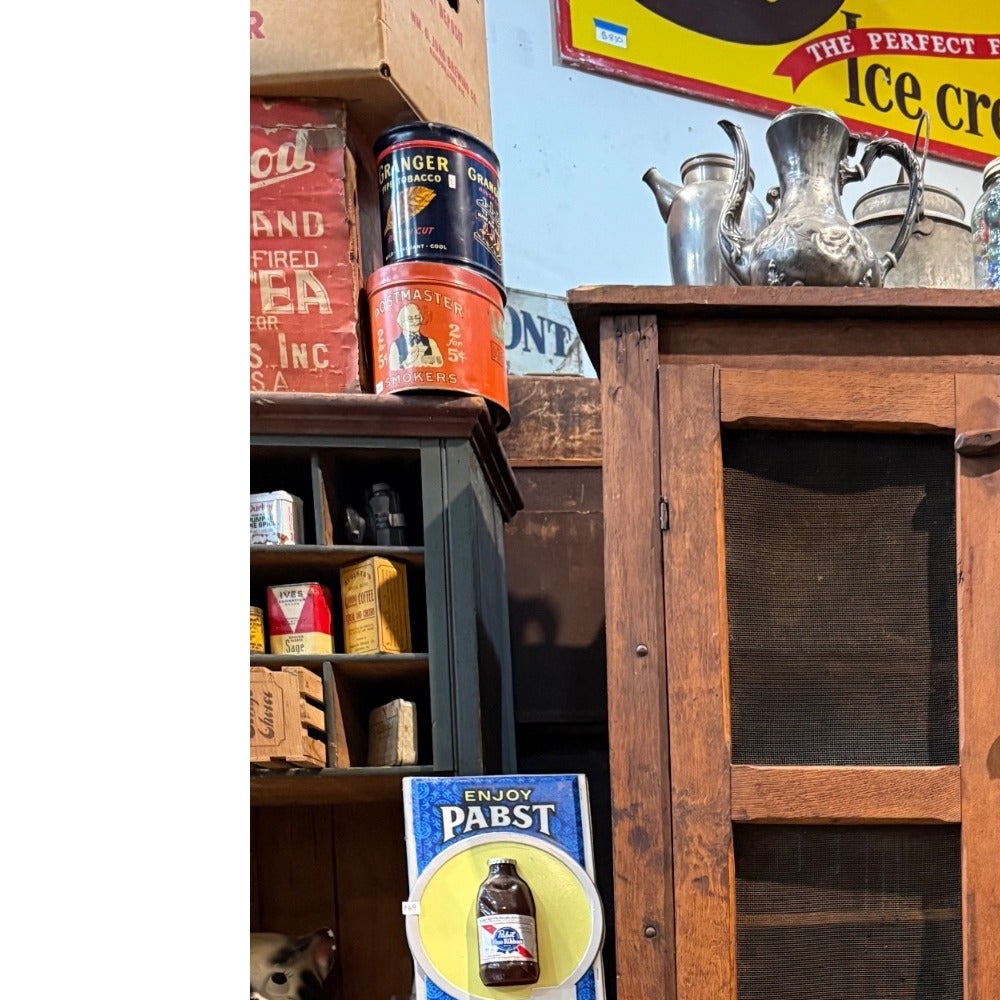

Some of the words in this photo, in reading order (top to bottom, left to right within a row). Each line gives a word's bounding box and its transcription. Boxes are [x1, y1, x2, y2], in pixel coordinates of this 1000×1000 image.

[806, 35, 854, 63] THE
[868, 32, 975, 55] PERFECT
[840, 10, 924, 120] Ice
[379, 154, 449, 184] GRANGER
[416, 226, 434, 235] CUT
[252, 250, 319, 269] FIRED
[375, 289, 464, 318] POSTMASTER
[448, 323, 461, 338] 2
[385, 372, 457, 386] SMOKERS
[280, 590, 303, 598] IVES
[285, 638, 305, 653] Sage
[464, 790, 532, 802] ENJOY
[440, 804, 555, 842] PABST
